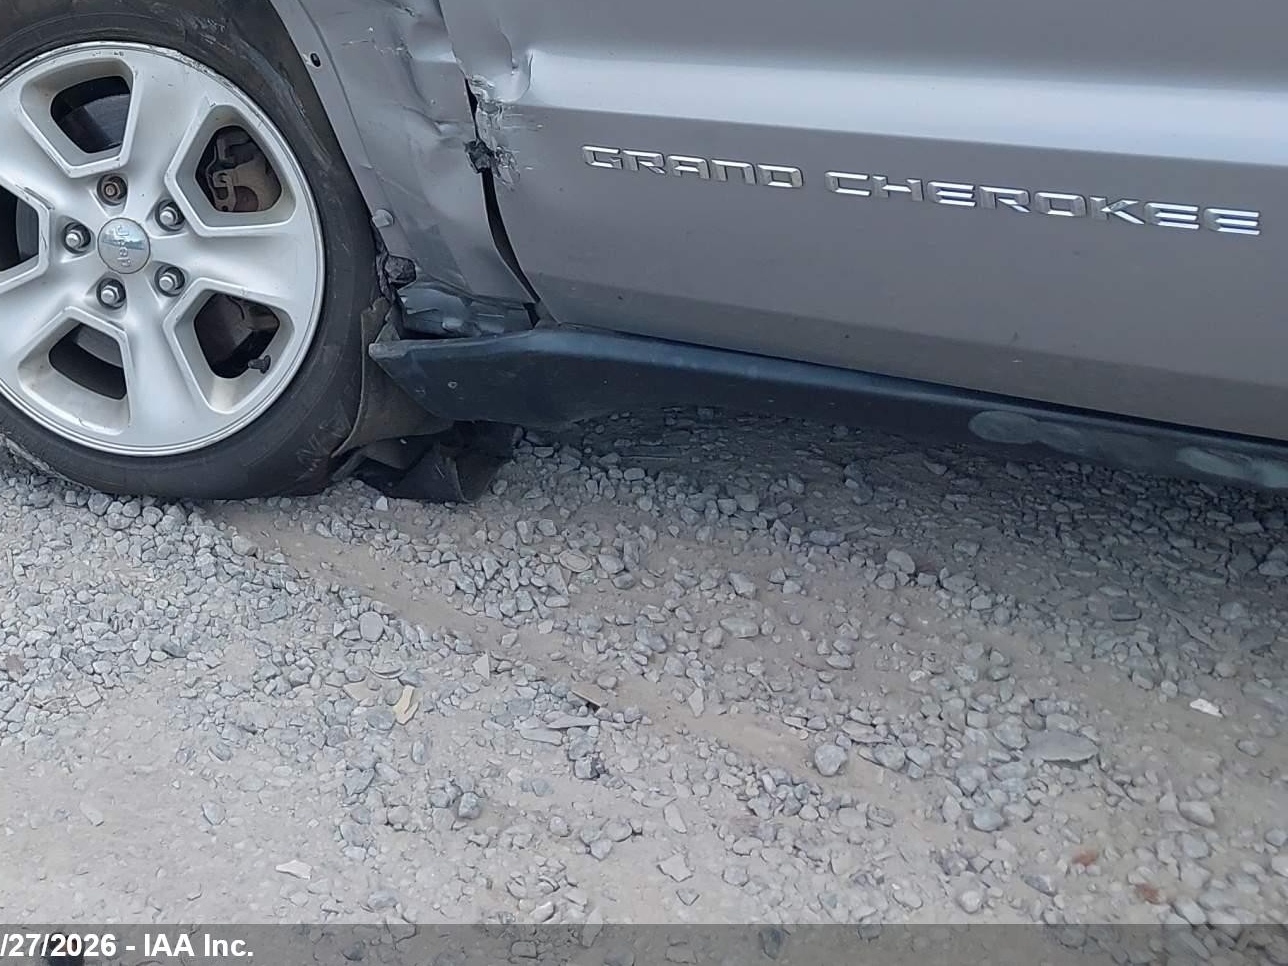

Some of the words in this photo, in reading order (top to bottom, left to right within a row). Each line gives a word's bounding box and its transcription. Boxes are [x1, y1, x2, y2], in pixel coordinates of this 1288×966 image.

[582, 144, 805, 188] GRAND
[824, 170, 1262, 236] CHEROKEE
[116, 224, 132, 268] Jeep
